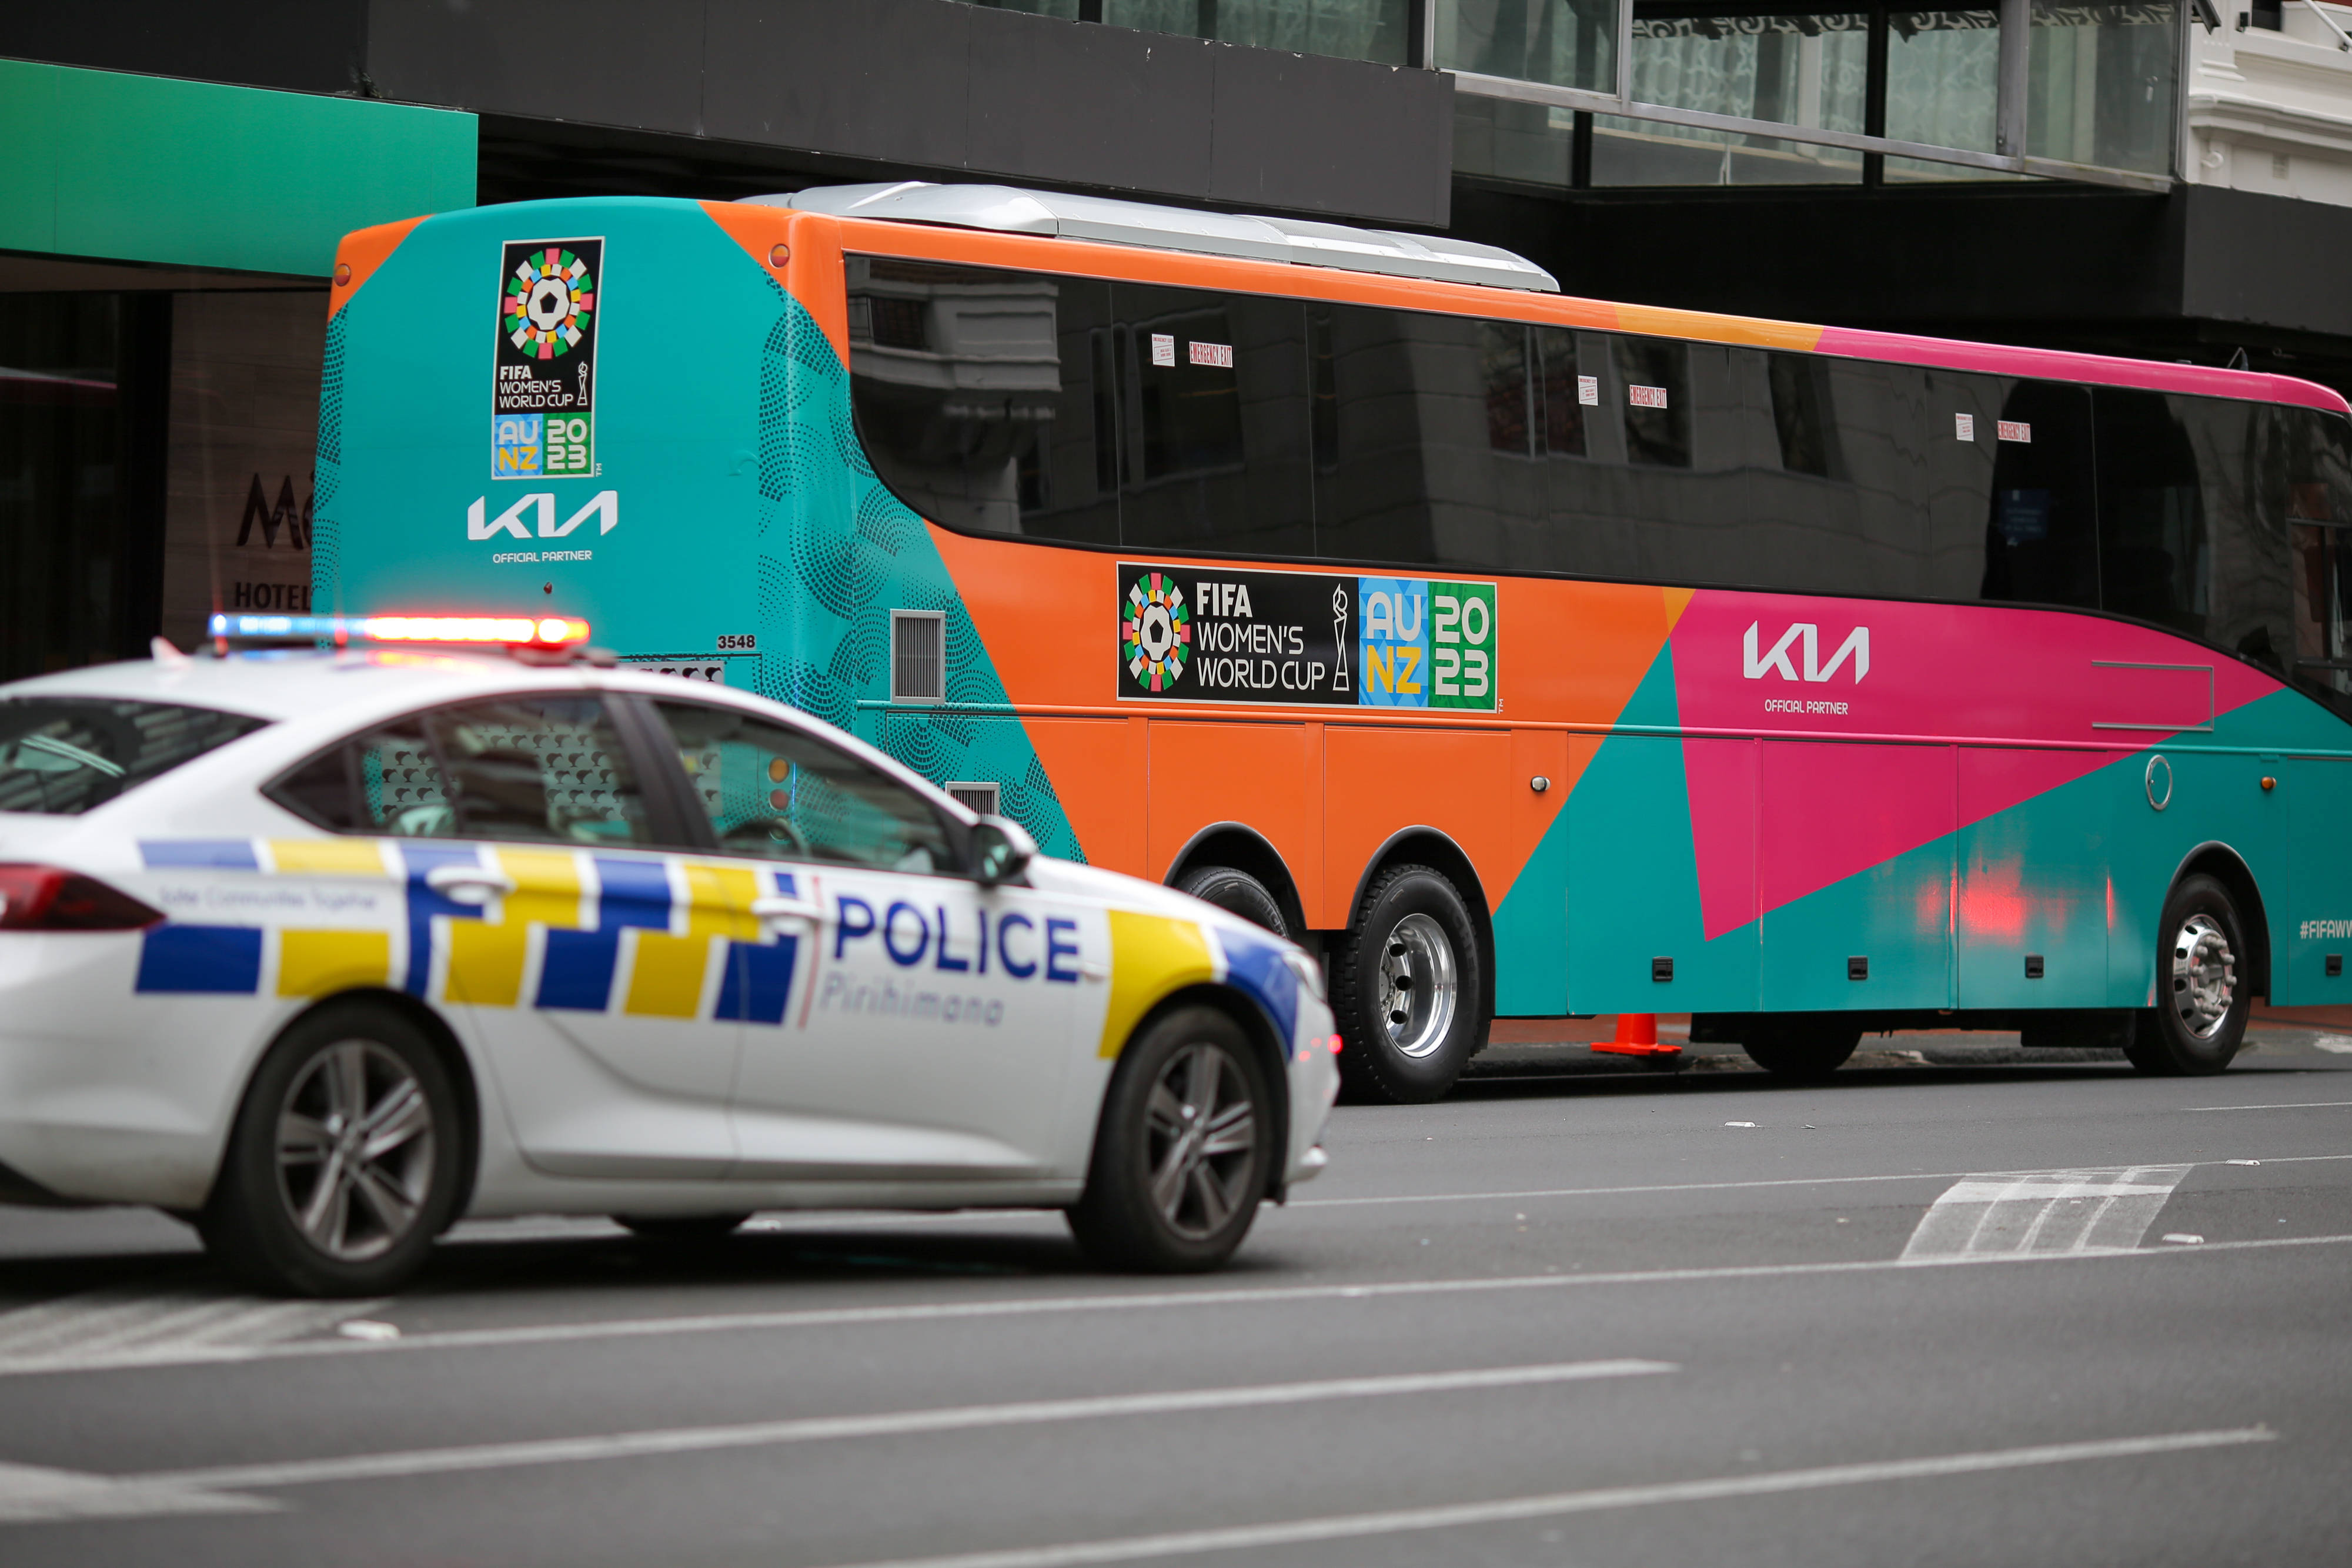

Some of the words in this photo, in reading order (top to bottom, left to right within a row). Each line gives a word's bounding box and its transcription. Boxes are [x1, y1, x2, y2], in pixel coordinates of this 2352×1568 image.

[1190, 343, 1219, 365] EMERGENCY
[1221, 346, 1231, 366] EXIT
[500, 365, 532, 380] FIFA
[499, 380, 562, 394] WOMEN'S
[1631, 386, 1655, 406] EMERGENCY
[1657, 389, 1666, 407] EXIT
[499, 395, 546, 408] WORLD
[547, 394, 574, 407] CUP
[499, 420, 539, 445] AU
[547, 418, 587, 444] 20
[499, 446, 539, 470] NZ
[547, 444, 587, 469] 23
[236, 472, 313, 550] M
[492, 551, 540, 563] OFFICIAL
[542, 550, 592, 562] PARTNER
[235, 582, 310, 610] HOTEL
[1196, 582, 1253, 617] FIFA
[1366, 591, 1422, 641] AU
[1435, 596, 1489, 646] 20
[717, 634, 756, 649] 3548
[1197, 623, 1304, 655] WOMEN'S
[1197, 657, 1277, 689] WORLD
[1282, 661, 1325, 690] CUP
[1366, 644, 1421, 694] NZ
[1435, 648, 1489, 697] 23
[1765, 699, 1805, 713] OFFICIAL
[1806, 700, 1849, 715] PARTNER
[834, 894, 1080, 984] POLICE
